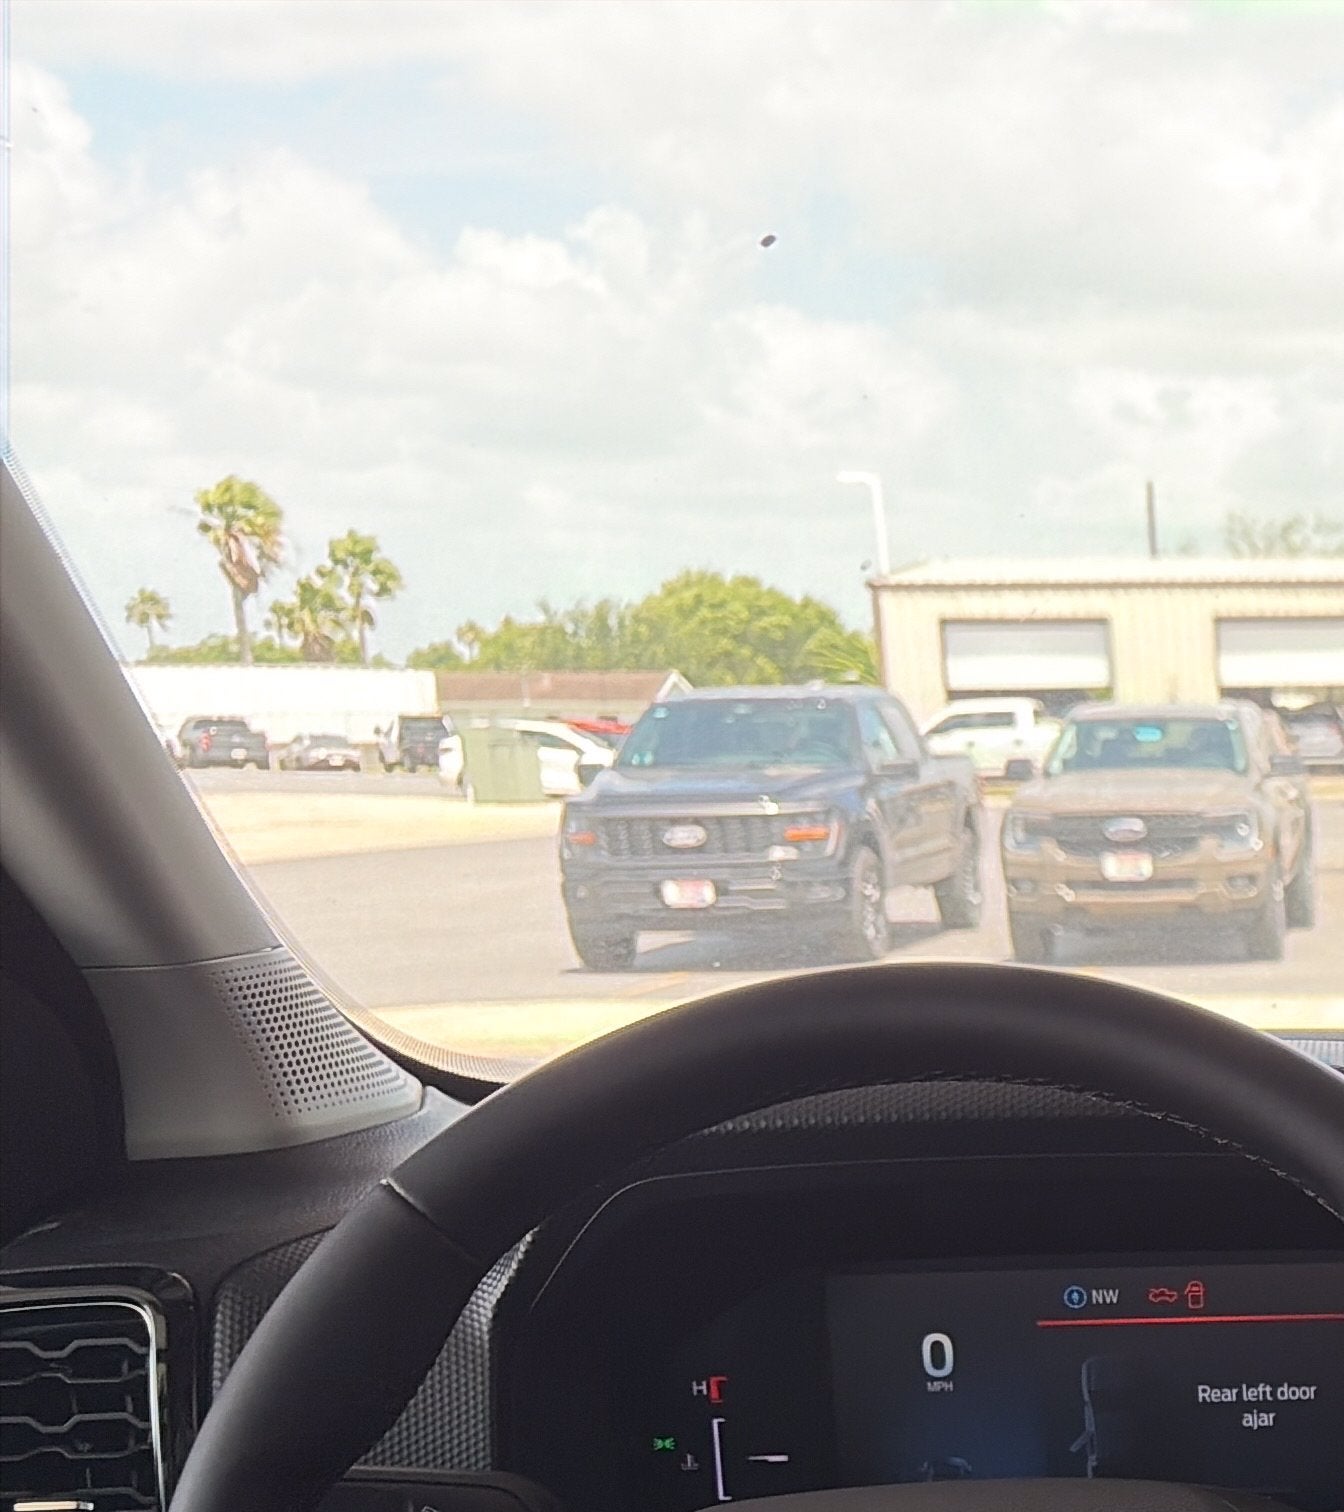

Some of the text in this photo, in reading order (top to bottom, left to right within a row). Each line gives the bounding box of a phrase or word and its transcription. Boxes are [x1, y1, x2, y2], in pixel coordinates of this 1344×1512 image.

[1092, 1288, 1119, 1306] NW
[921, 1332, 955, 1378] 0
[692, 1380, 708, 1396] H
[926, 1381, 953, 1393] MPH
[1197, 1382, 1317, 1404] Rear left door
[1242, 1411, 1275, 1431] ajar
